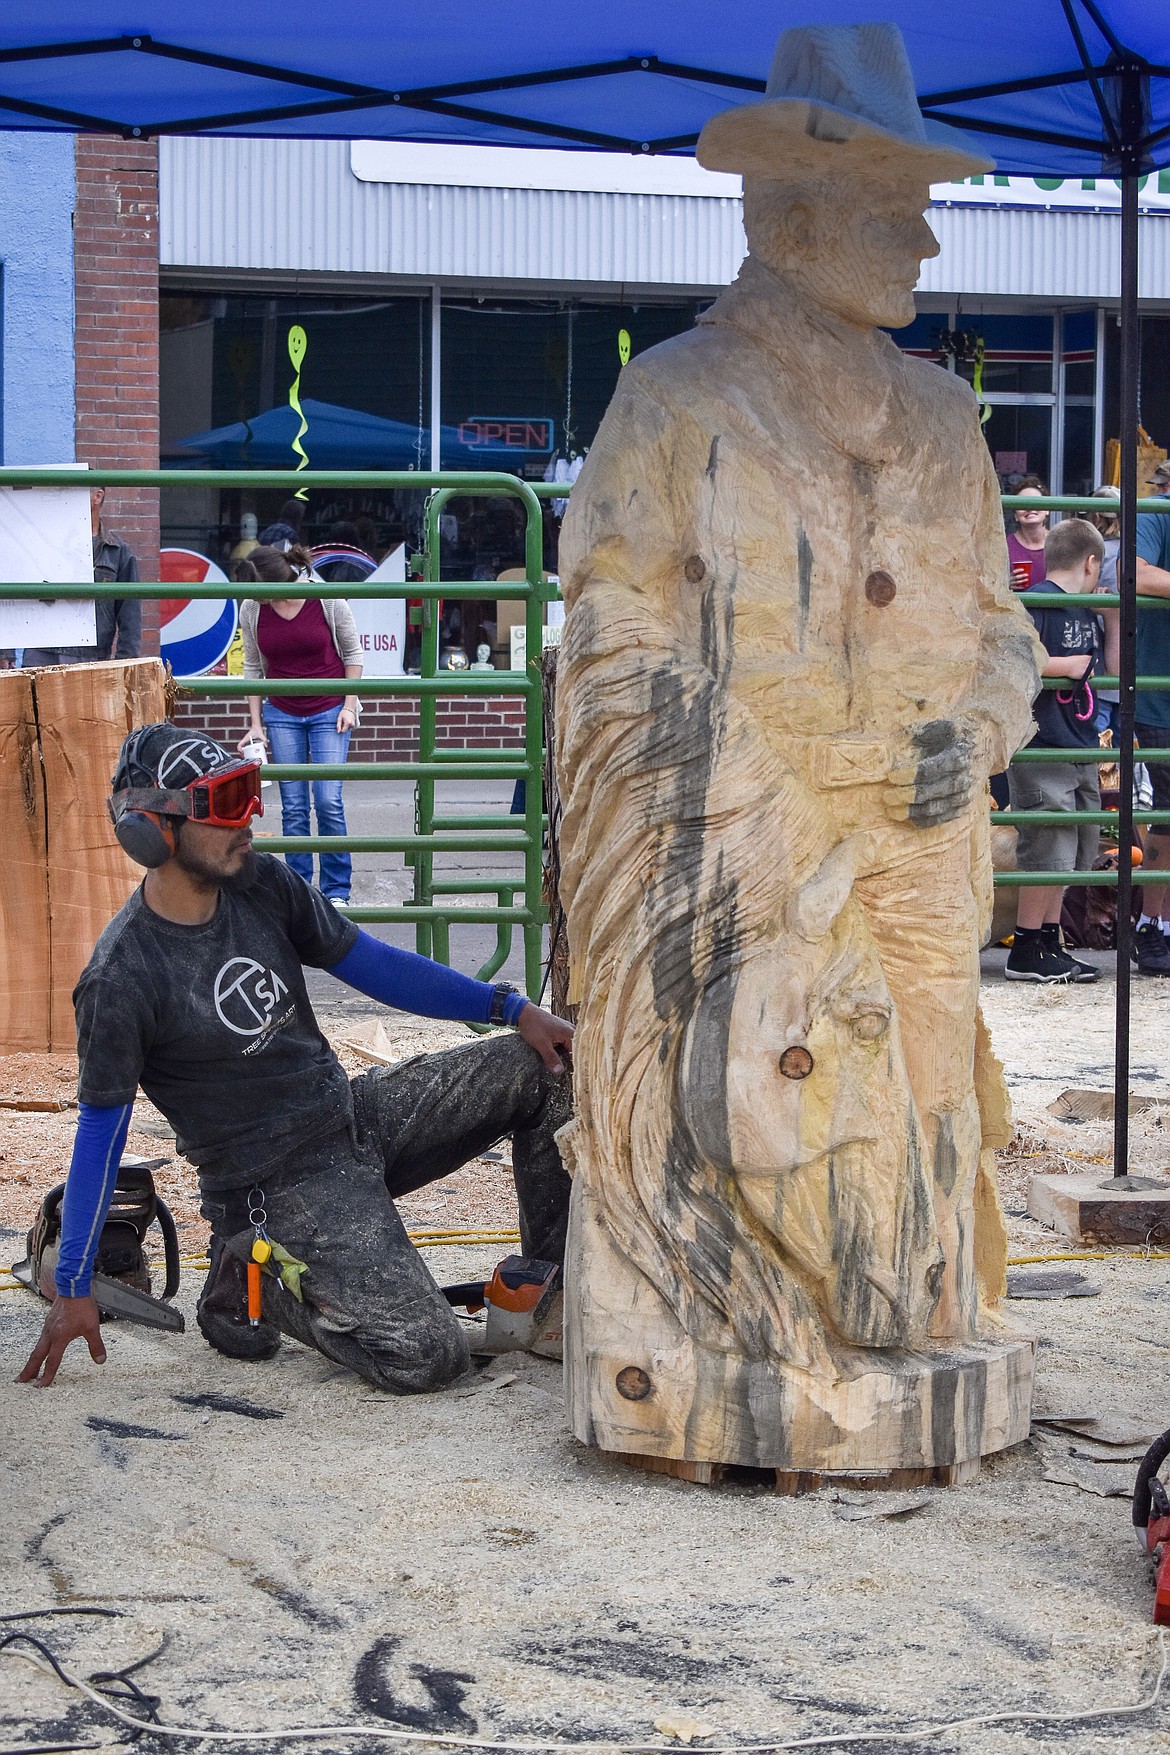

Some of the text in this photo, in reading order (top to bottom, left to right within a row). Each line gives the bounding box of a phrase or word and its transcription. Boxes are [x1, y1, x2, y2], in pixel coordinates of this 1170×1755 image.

[459, 422, 546, 447] OPEN
[373, 634, 398, 651] USA
[241, 1037, 262, 1056] TREE
[285, 1003, 296, 1018] ART
